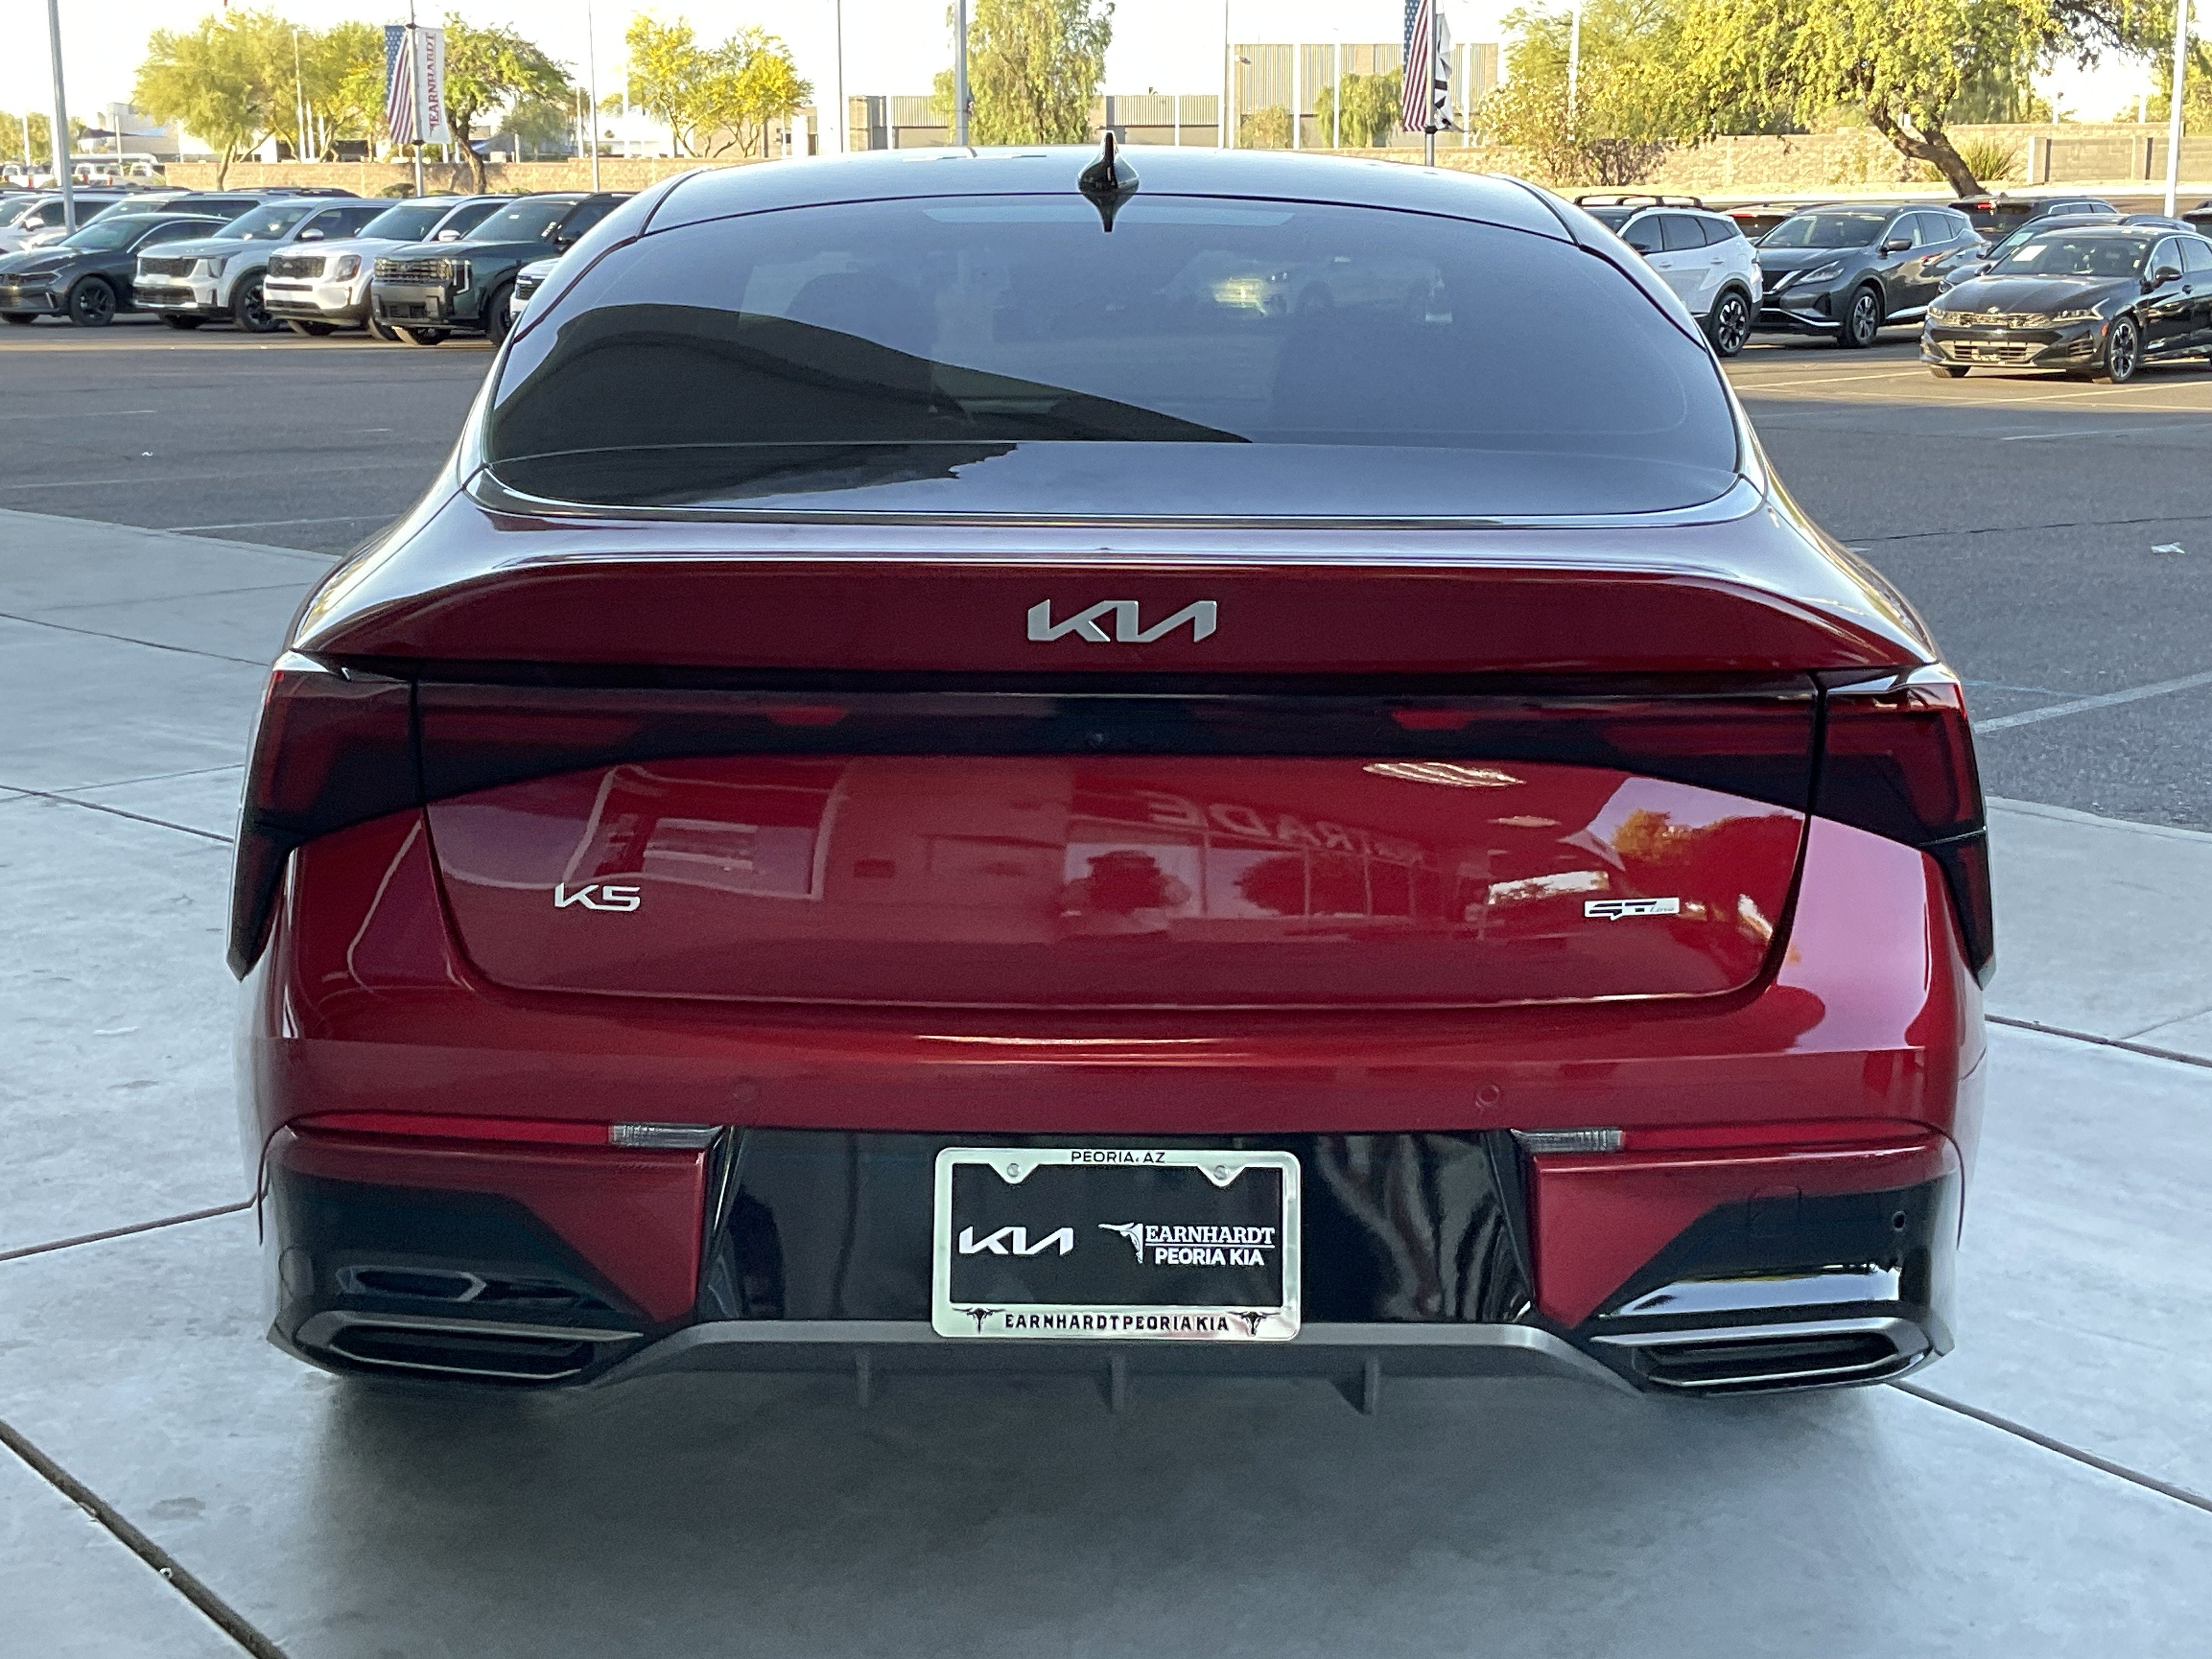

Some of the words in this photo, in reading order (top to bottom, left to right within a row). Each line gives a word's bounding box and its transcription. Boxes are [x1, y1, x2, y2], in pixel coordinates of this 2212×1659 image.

[425, 32, 439, 125] EARNHARDT
[1028, 599, 1217, 642] KIA
[555, 882, 640, 911] K5
[1143, 1152, 1165, 1163] AZ
[959, 1226, 1074, 1255] KIA
[1146, 1226, 1276, 1244] EARNHARDT
[1155, 1248, 1226, 1265] PEORIA
[1230, 1249, 1265, 1265] KIA
